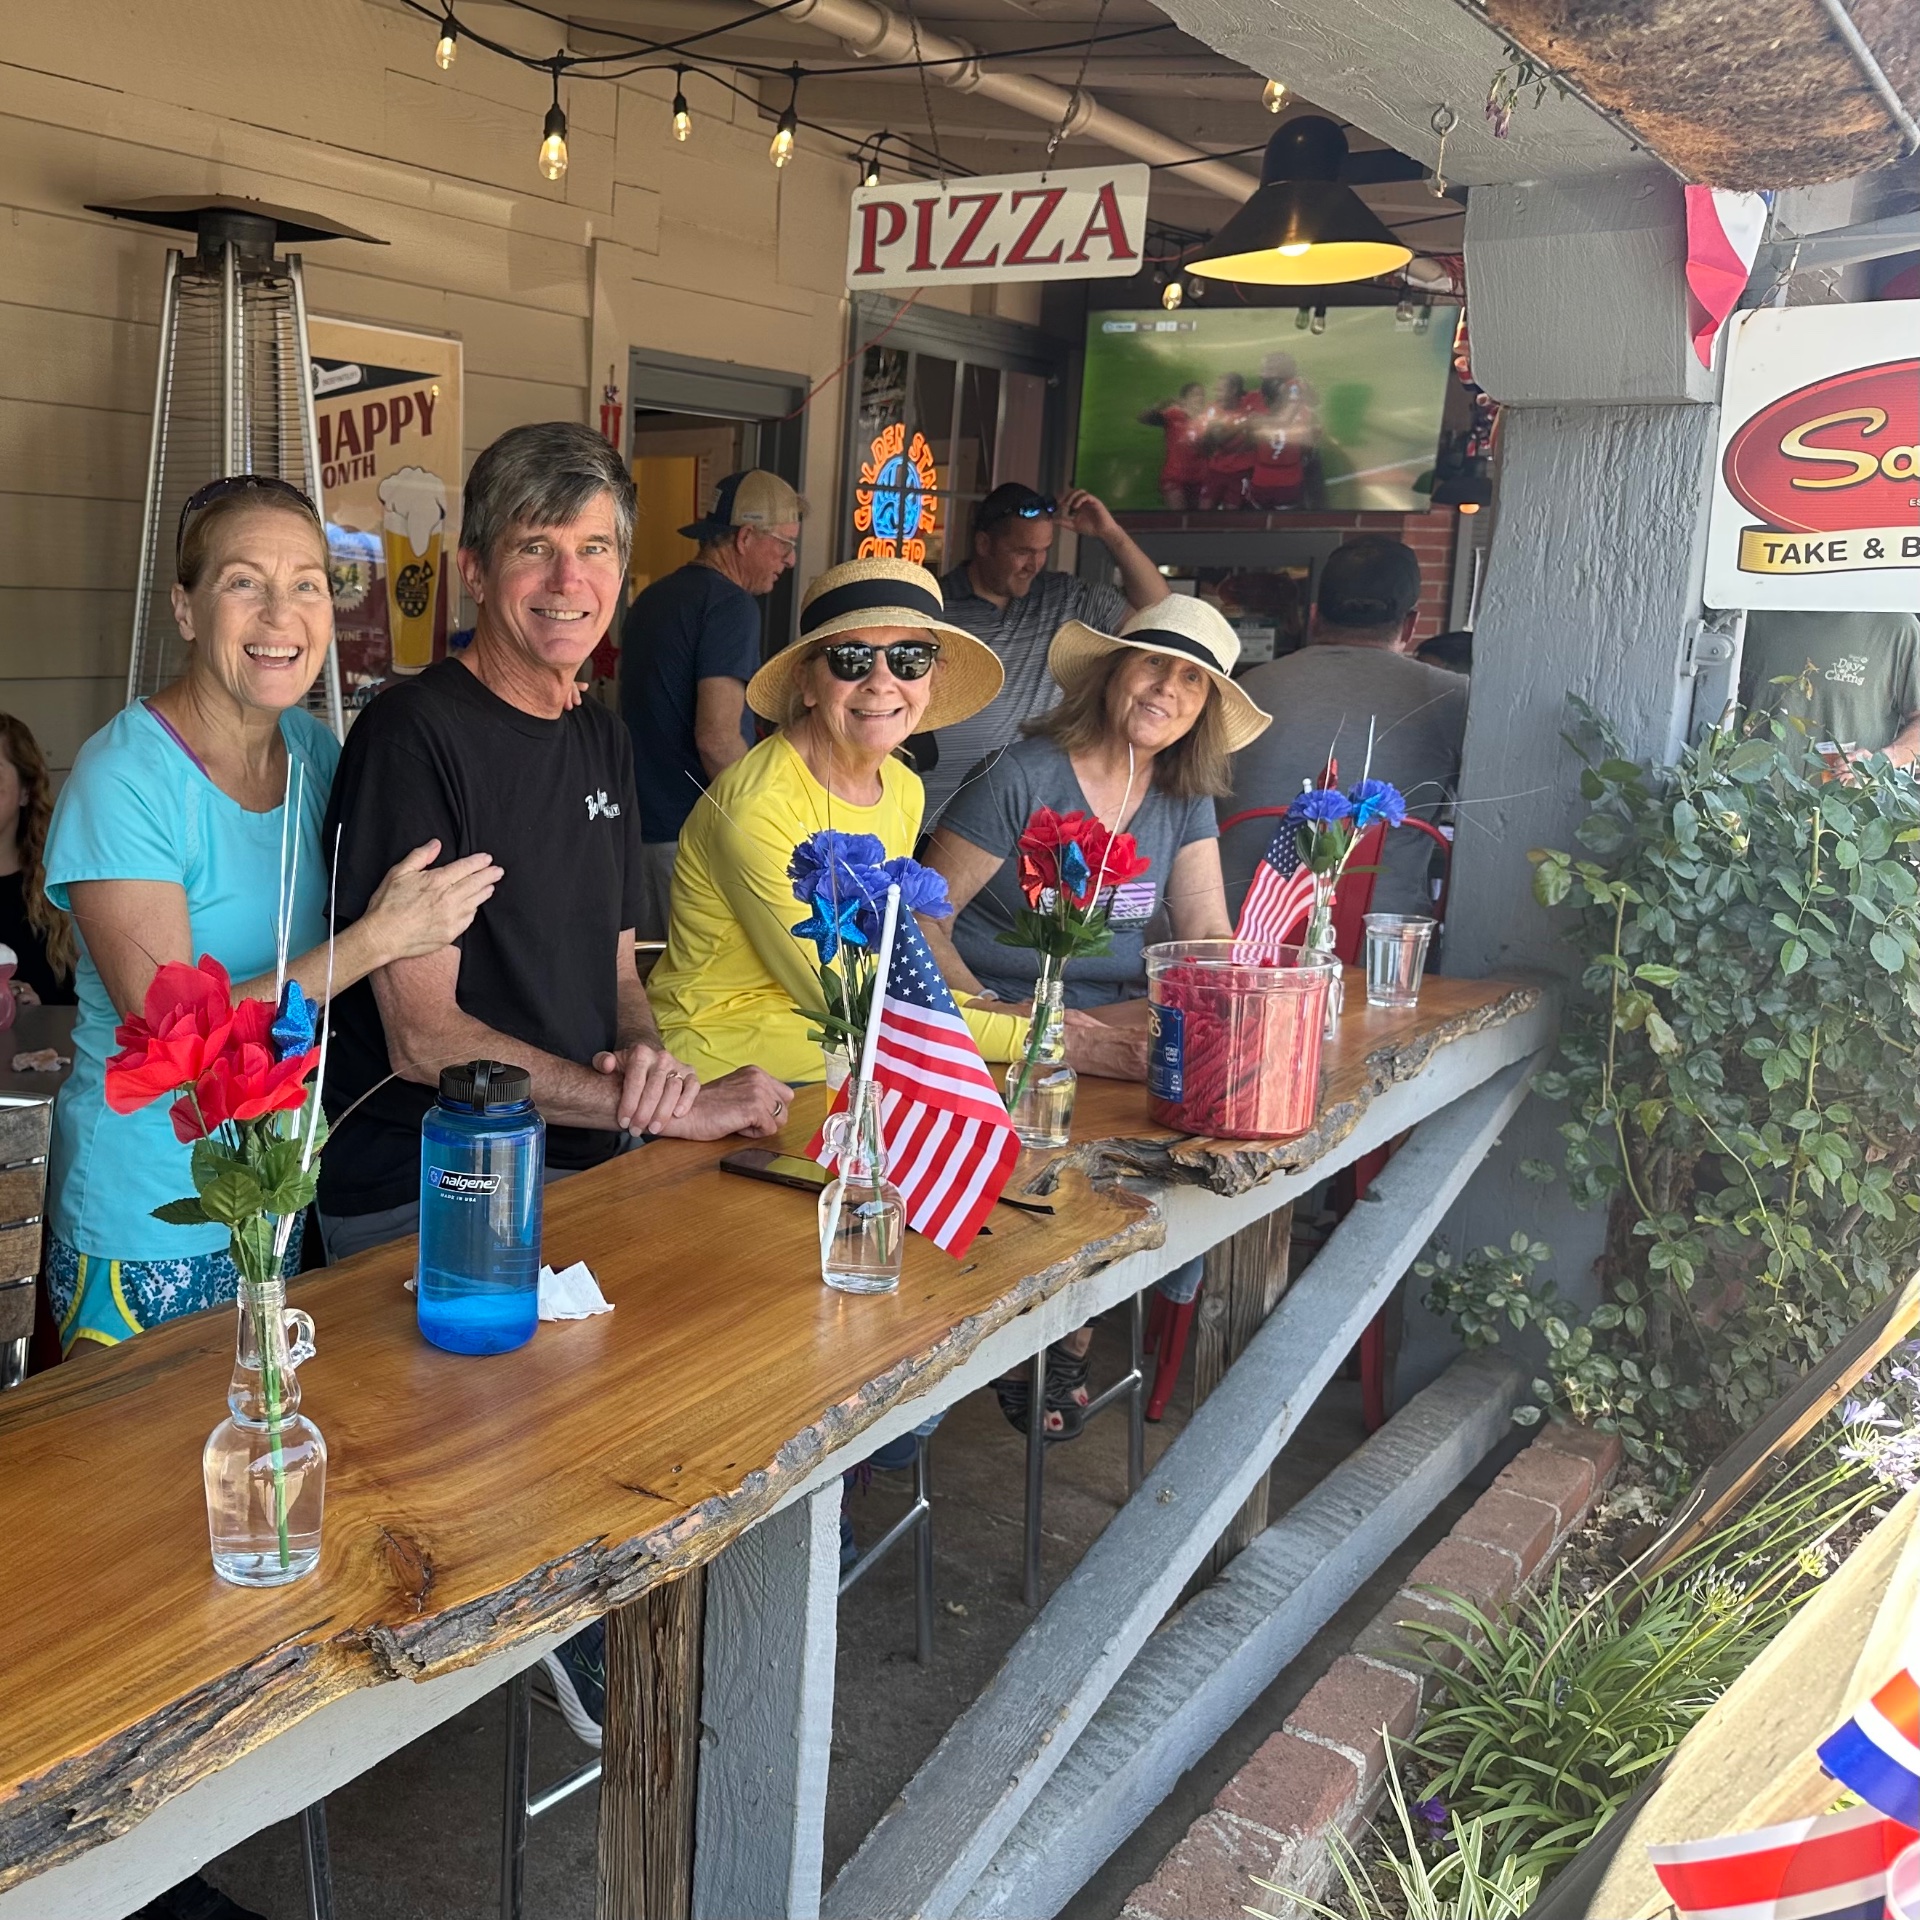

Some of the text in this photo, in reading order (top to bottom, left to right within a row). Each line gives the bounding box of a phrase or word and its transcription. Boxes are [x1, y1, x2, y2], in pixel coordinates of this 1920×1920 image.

[853, 180, 1138, 276] PIZZA
[322, 453, 376, 490] ONTH
[1763, 540, 1848, 564] TAKE
[1863, 537, 1885, 560] &
[344, 697, 368, 710] DAY
[441, 1175, 496, 1190] nalgene
[440, 1192, 455, 1200] MADE
